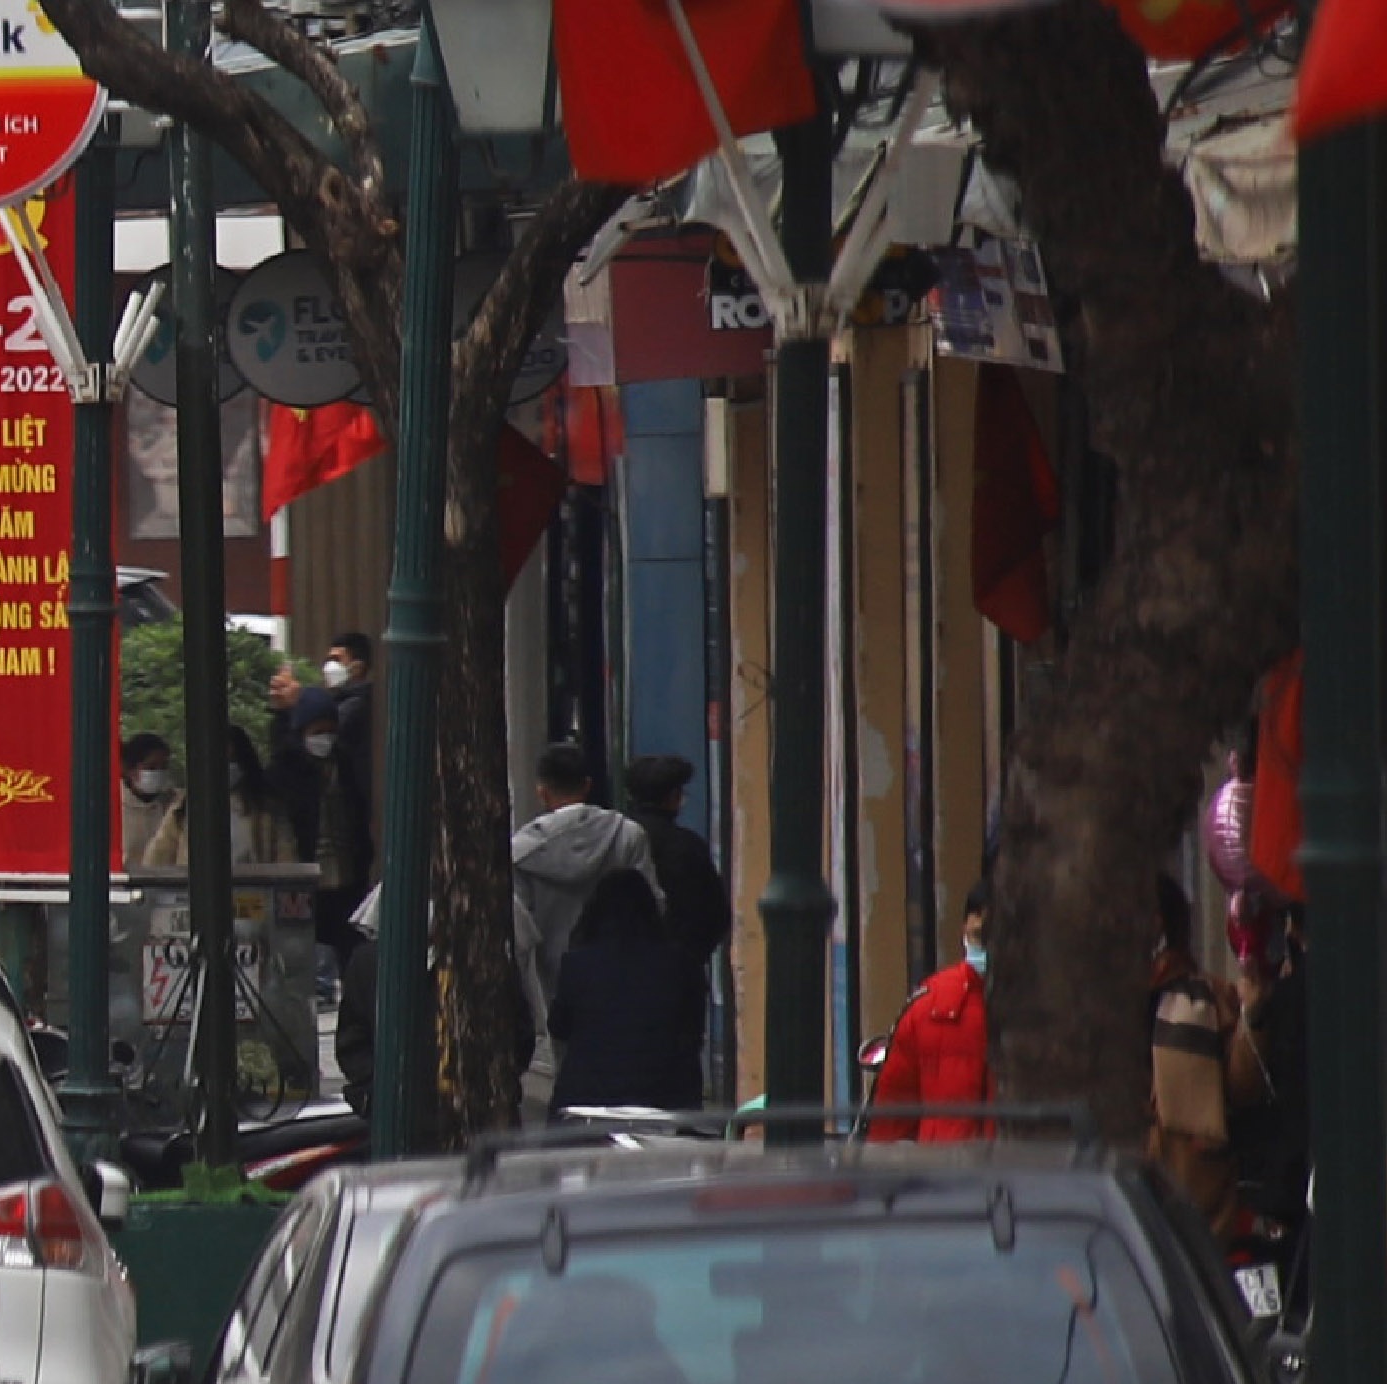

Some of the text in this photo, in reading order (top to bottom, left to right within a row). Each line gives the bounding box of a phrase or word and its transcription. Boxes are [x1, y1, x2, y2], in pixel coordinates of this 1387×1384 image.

[4, 113, 39, 135] ÍCH
[0, 365, 66, 392] 2022
[2, 413, 47, 453] LIỆT
[44, 550, 70, 588] LẬ
[40, 590, 70, 629] SẢ
[47, 647, 55, 676] !
